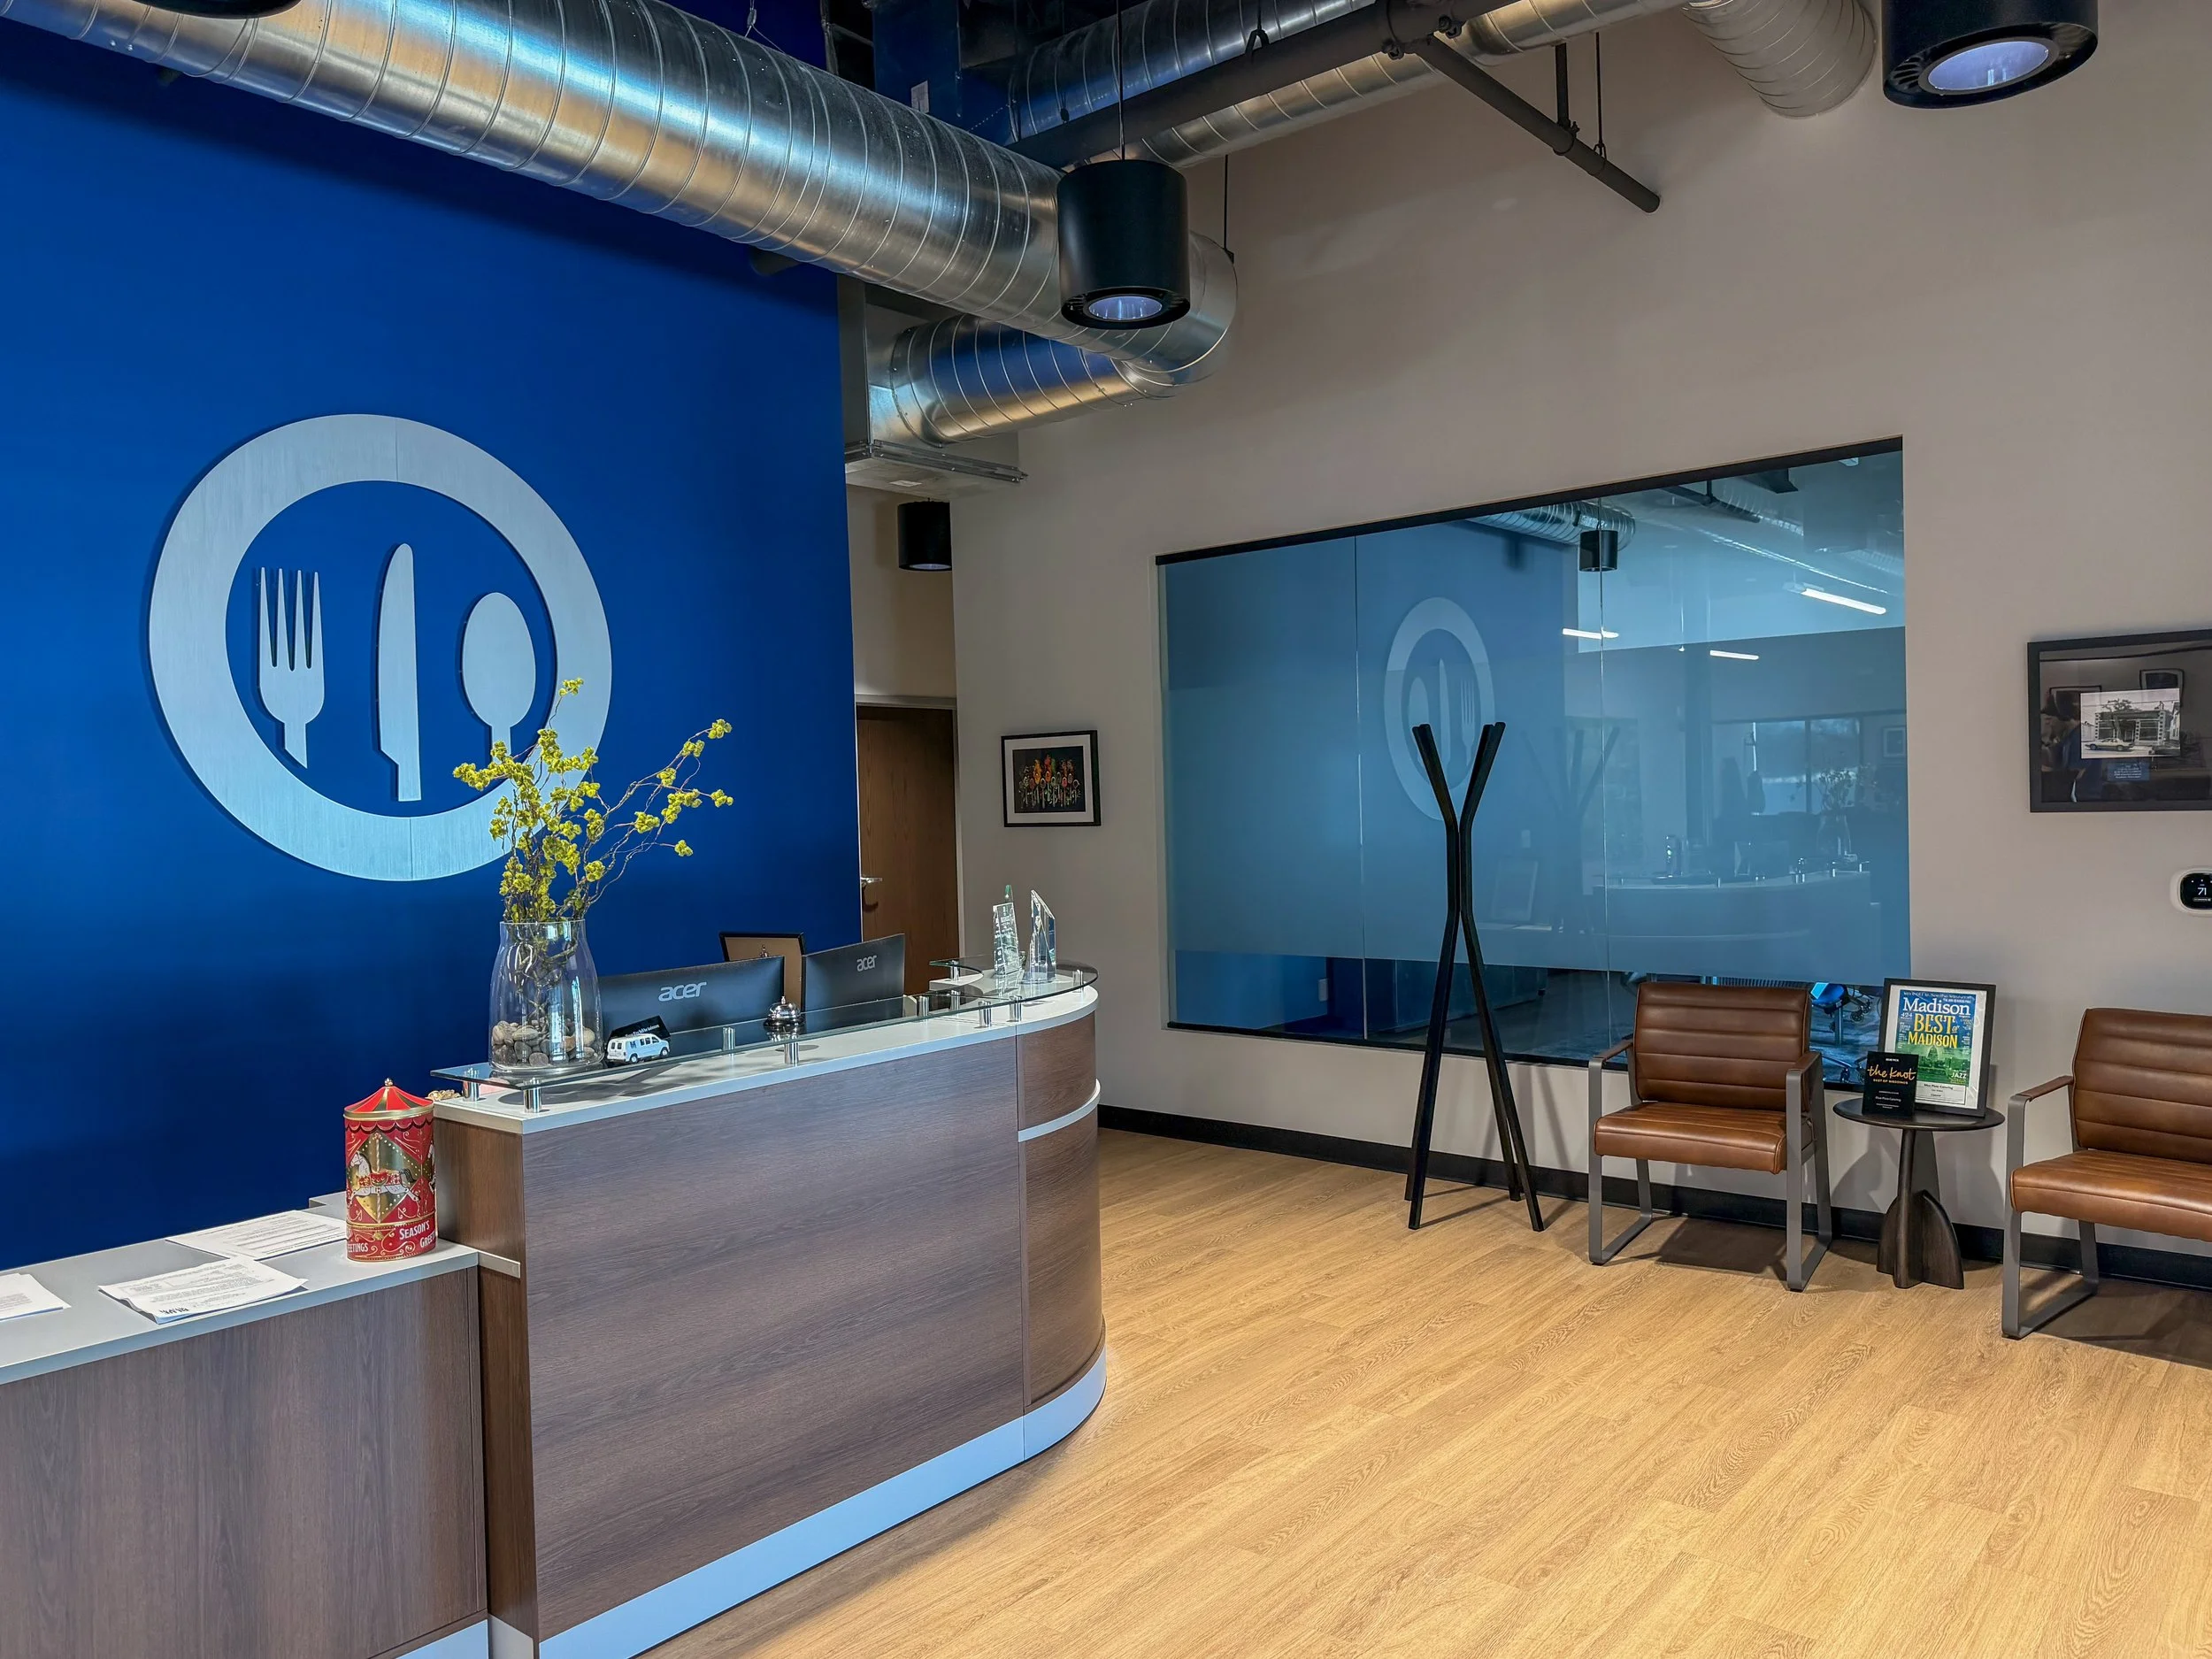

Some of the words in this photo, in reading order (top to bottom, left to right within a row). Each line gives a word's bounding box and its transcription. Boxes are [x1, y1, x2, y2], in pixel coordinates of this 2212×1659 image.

[2197, 887, 2207, 895] 71
[856, 955, 877, 972] acer
[658, 981, 707, 1001] acer
[1902, 996, 1970, 1016] Madison
[1914, 1013, 1956, 1033] BEST
[1908, 1032, 1958, 1048] MADISON
[1867, 1064, 1888, 1077] the
[1889, 1066, 1916, 1080] knot
[399, 1220, 430, 1240] SEASON'S
